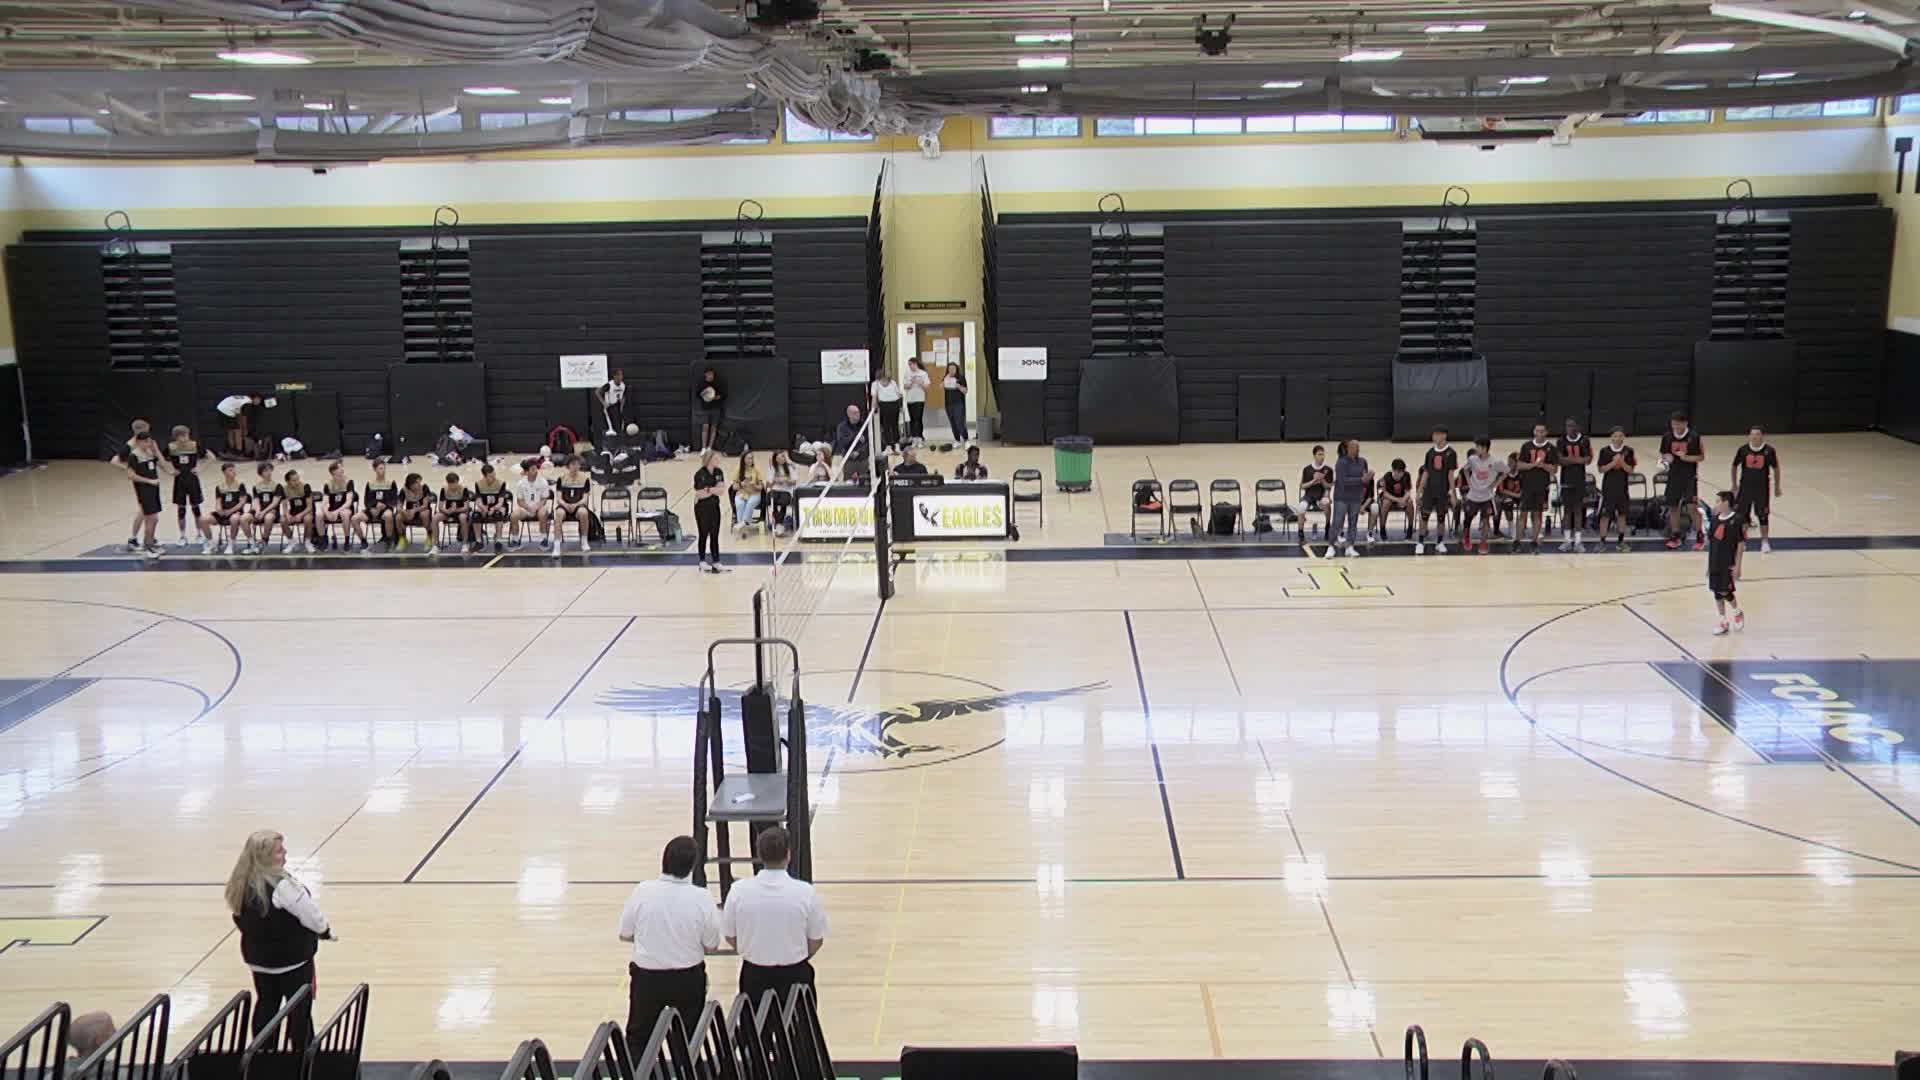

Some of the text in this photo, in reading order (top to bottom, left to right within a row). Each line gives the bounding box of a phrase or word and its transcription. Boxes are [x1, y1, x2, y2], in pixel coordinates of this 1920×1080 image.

[802, 505, 875, 529] TRUMBU
[942, 504, 1003, 528] EAGLES
[1749, 673, 1905, 746] FCIAC
